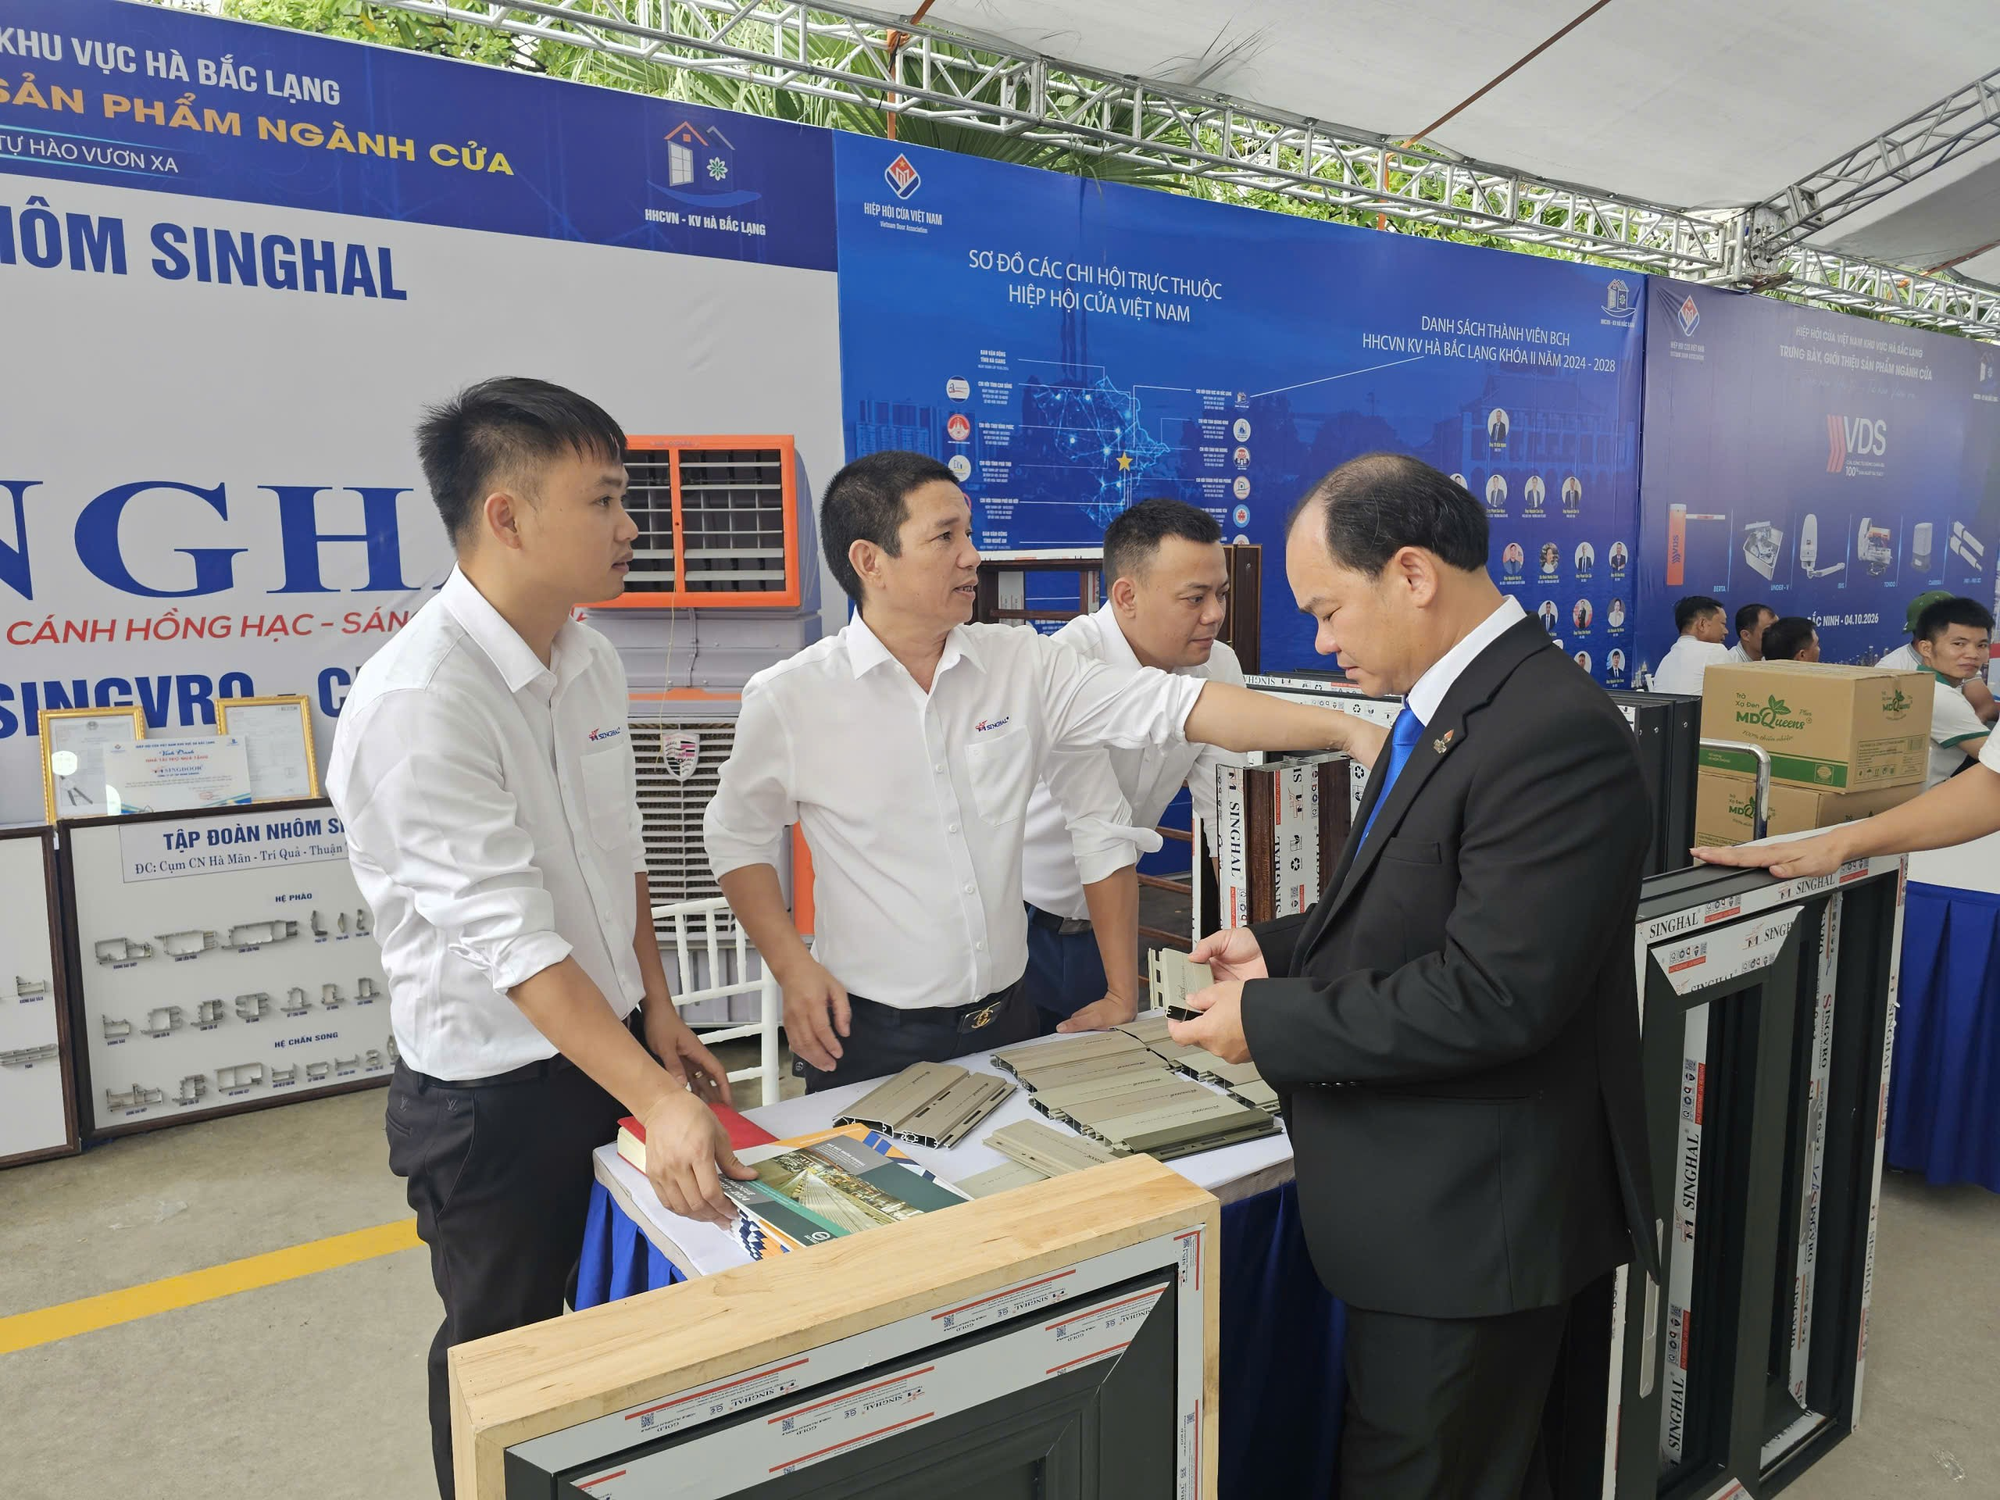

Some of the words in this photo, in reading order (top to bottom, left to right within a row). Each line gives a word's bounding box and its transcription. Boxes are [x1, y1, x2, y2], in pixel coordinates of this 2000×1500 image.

[71, 37, 136, 75] VỰC
[145, 49, 190, 82] HÀ
[198, 53, 257, 92] BẮC
[265, 69, 340, 105] LẠNG
[103, 92, 241, 136] PHẨM
[257, 116, 415, 161] NGÀNH
[429, 140, 515, 175] CỬA
[29, 138, 78, 160] HÀO
[82, 145, 145, 169] VƯƠN
[151, 155, 179, 173] XA
[644, 208, 680, 225] HHCVN
[688, 214, 702, 228] KV
[703, 214, 718, 230] HÀ
[719, 215, 739, 233] BẮC
[740, 221, 766, 236] LẠNG
[864, 202, 880, 217] HIỆP
[881, 204, 895, 218] HỘI
[895, 206, 909, 221] CỬA
[910, 208, 925, 224] VIỆT
[925, 212, 943, 226] NAM
[150, 222, 408, 301] SINGHAL
[968, 249, 994, 270] SƠ
[997, 251, 1024, 274] ĐỒ
[1028, 256, 1063, 279] CÁC
[1065, 263, 1093, 283] CHI
[1097, 266, 1125, 288] HỘI
[1128, 271, 1169, 295] TRỰC
[1170, 276, 1222, 302] THUỘC
[1008, 283, 1046, 309] HIỆP
[1050, 287, 1079, 313] HỘI
[1083, 291, 1117, 315] CỬA
[1119, 297, 1152, 321] VIỆT
[1155, 301, 1190, 322] NAM
[1421, 315, 1454, 333] DANH
[1457, 317, 1485, 337] SÁCH
[1487, 321, 1524, 341] THÀNH
[1525, 324, 1549, 344] VIÊN
[1550, 331, 1570, 346] BCH
[1362, 333, 1405, 352] HHCVN
[1407, 337, 1423, 354] KV
[1424, 336, 1441, 356] HÀ
[1443, 339, 1467, 359] BẮC
[1467, 344, 1497, 364] LẠNG
[1499, 345, 1528, 364] KHÓA
[1538, 347, 1562, 367] NĂM
[1563, 354, 1587, 370] 2024
[1593, 357, 1616, 373] 2028
[1844, 415, 1887, 456] VDS
[7, 612, 116, 646] CÁNH
[125, 607, 232, 643] HỒNG
[240, 612, 313, 644] HẠC
[1823, 615, 1839, 626] NINH
[1844, 613, 1879, 626] 04.10.2026
[163, 831, 200, 853] TẬP
[207, 823, 261, 846] ĐOÀN
[266, 817, 322, 842] NHÔM
[1229, 801, 1241, 878] SINGHAL
[135, 862, 157, 875] ĐC:
[159, 859, 186, 873] Cụm
[189, 856, 206, 869] CN
[209, 852, 225, 867] Hà
[227, 852, 252, 866] Mãn
[259, 849, 276, 862] Trí
[279, 845, 301, 861] Quả
[309, 842, 343, 858] Thuận
[275, 894, 288, 904] HỆ
[1796, 874, 1835, 895] SINGHAL
[1649, 911, 1699, 939] SINGHAL
[274, 1038, 287, 1049] HỆ
[315, 1030, 339, 1042] SONG
[1682, 1134, 1699, 1210] SINGHAL
[731, 1388, 774, 1407] SINGHAL
[863, 1395, 903, 1411] SINGHAL
[1669, 1378, 1685, 1452] SINGHAL
[657, 1421, 679, 1433] GOLD
